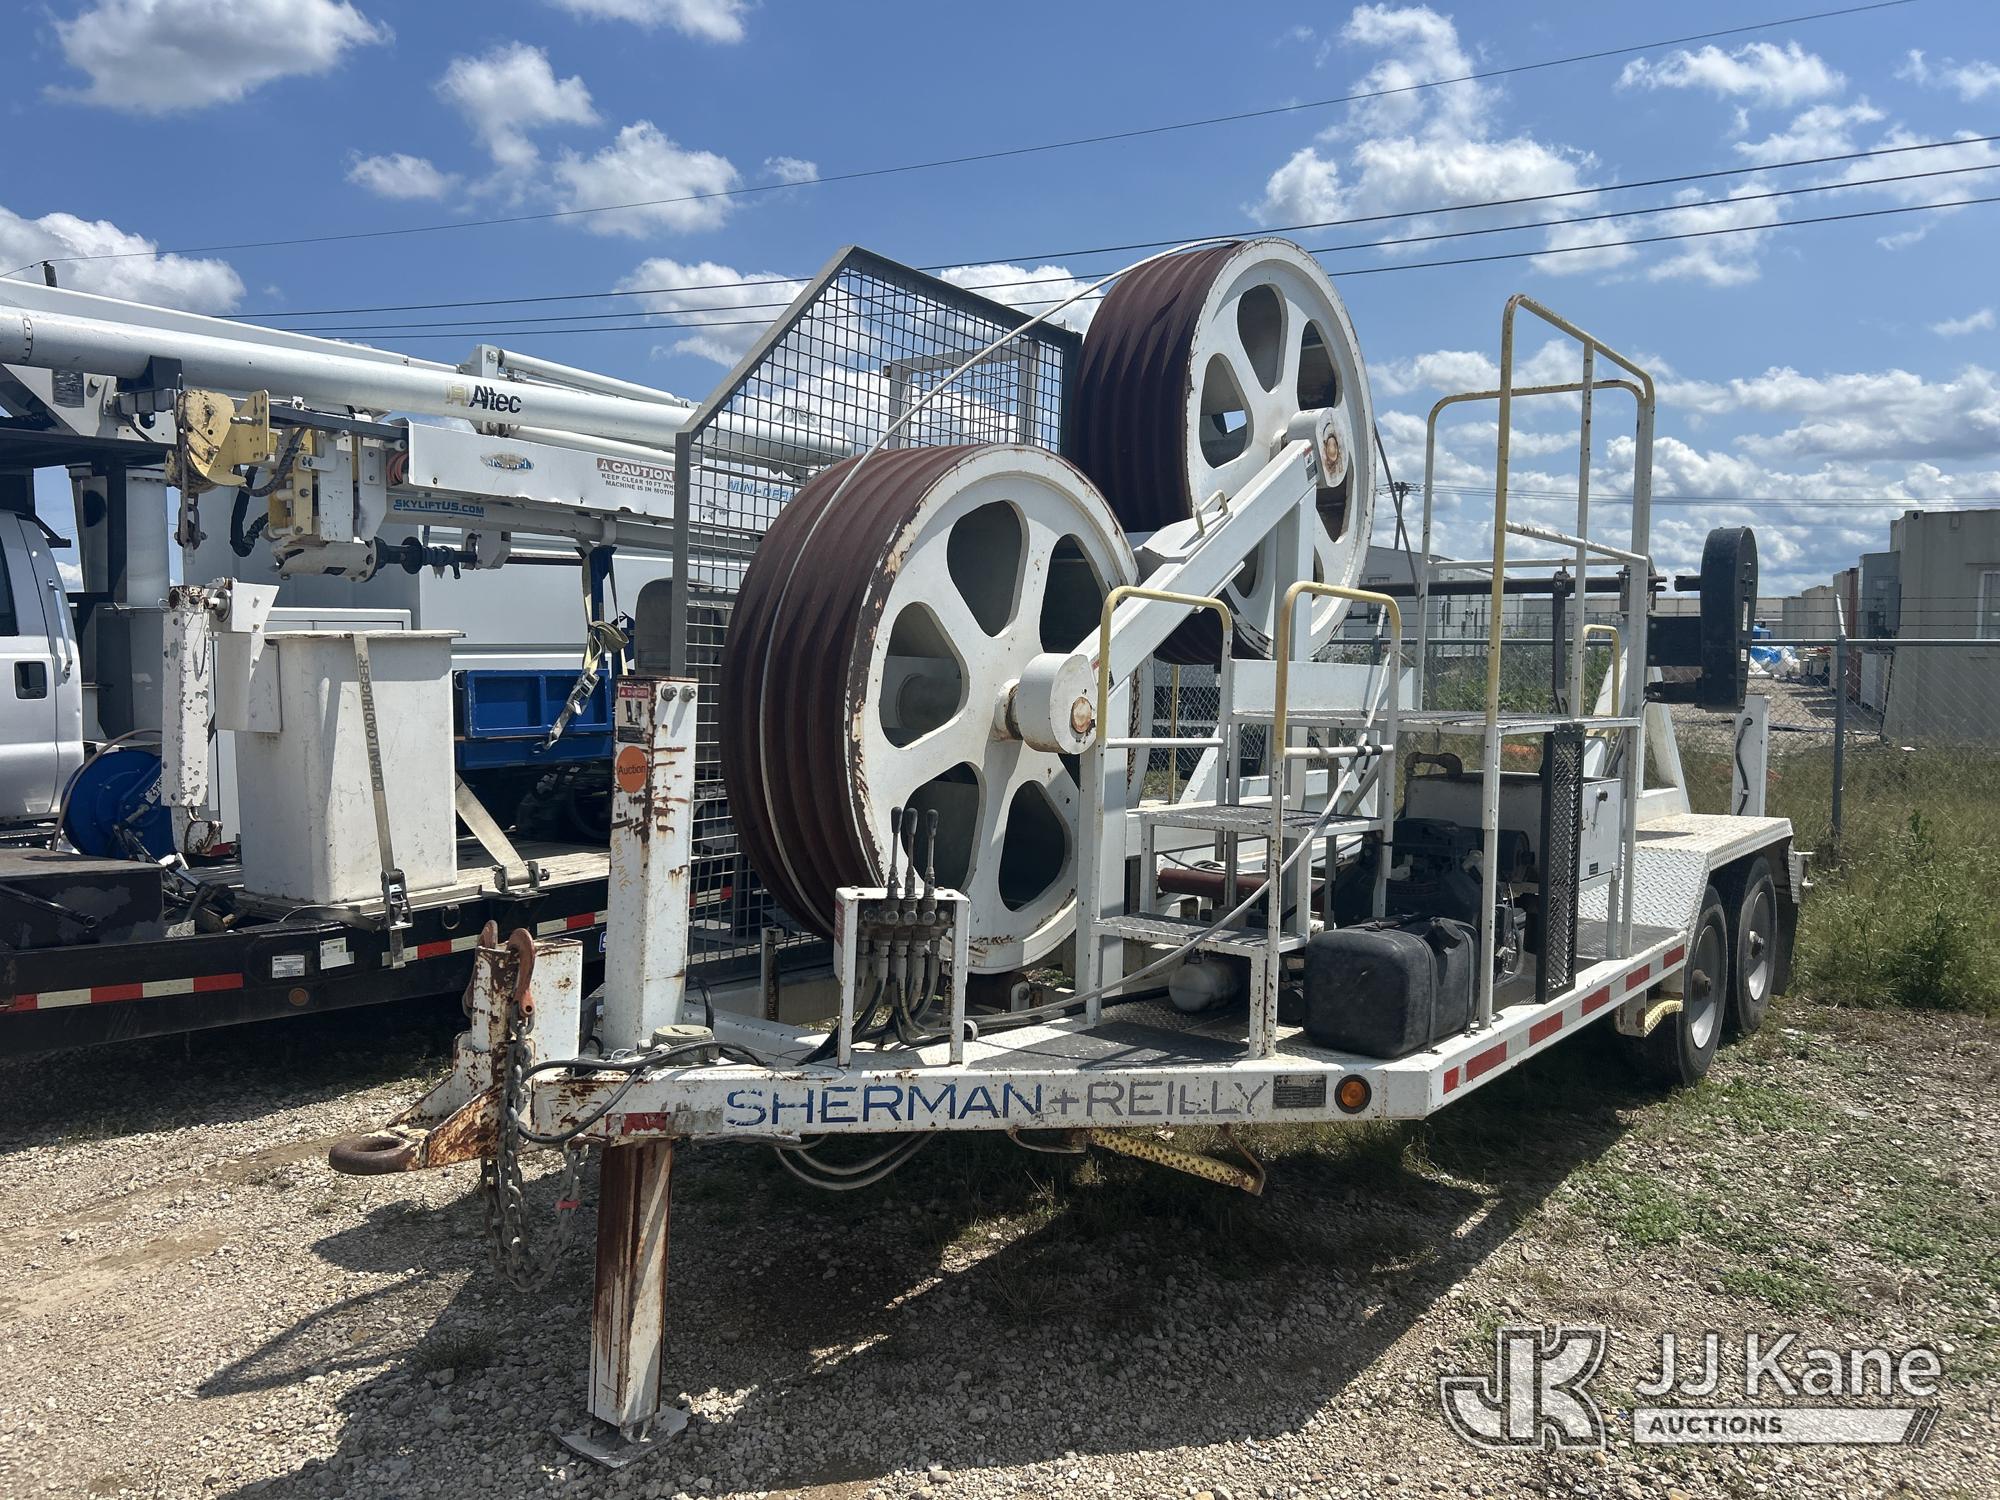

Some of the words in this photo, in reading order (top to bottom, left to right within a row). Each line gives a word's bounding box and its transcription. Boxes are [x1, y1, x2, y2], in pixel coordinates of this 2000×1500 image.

[469, 384, 521, 413] Altec
[612, 462, 673, 481] CAUTION
[606, 480, 635, 490] MACHINE
[622, 476, 644, 485] CLEAR
[394, 499, 485, 516] SKYLIFTUS.COM
[618, 765, 646, 775] Auction
